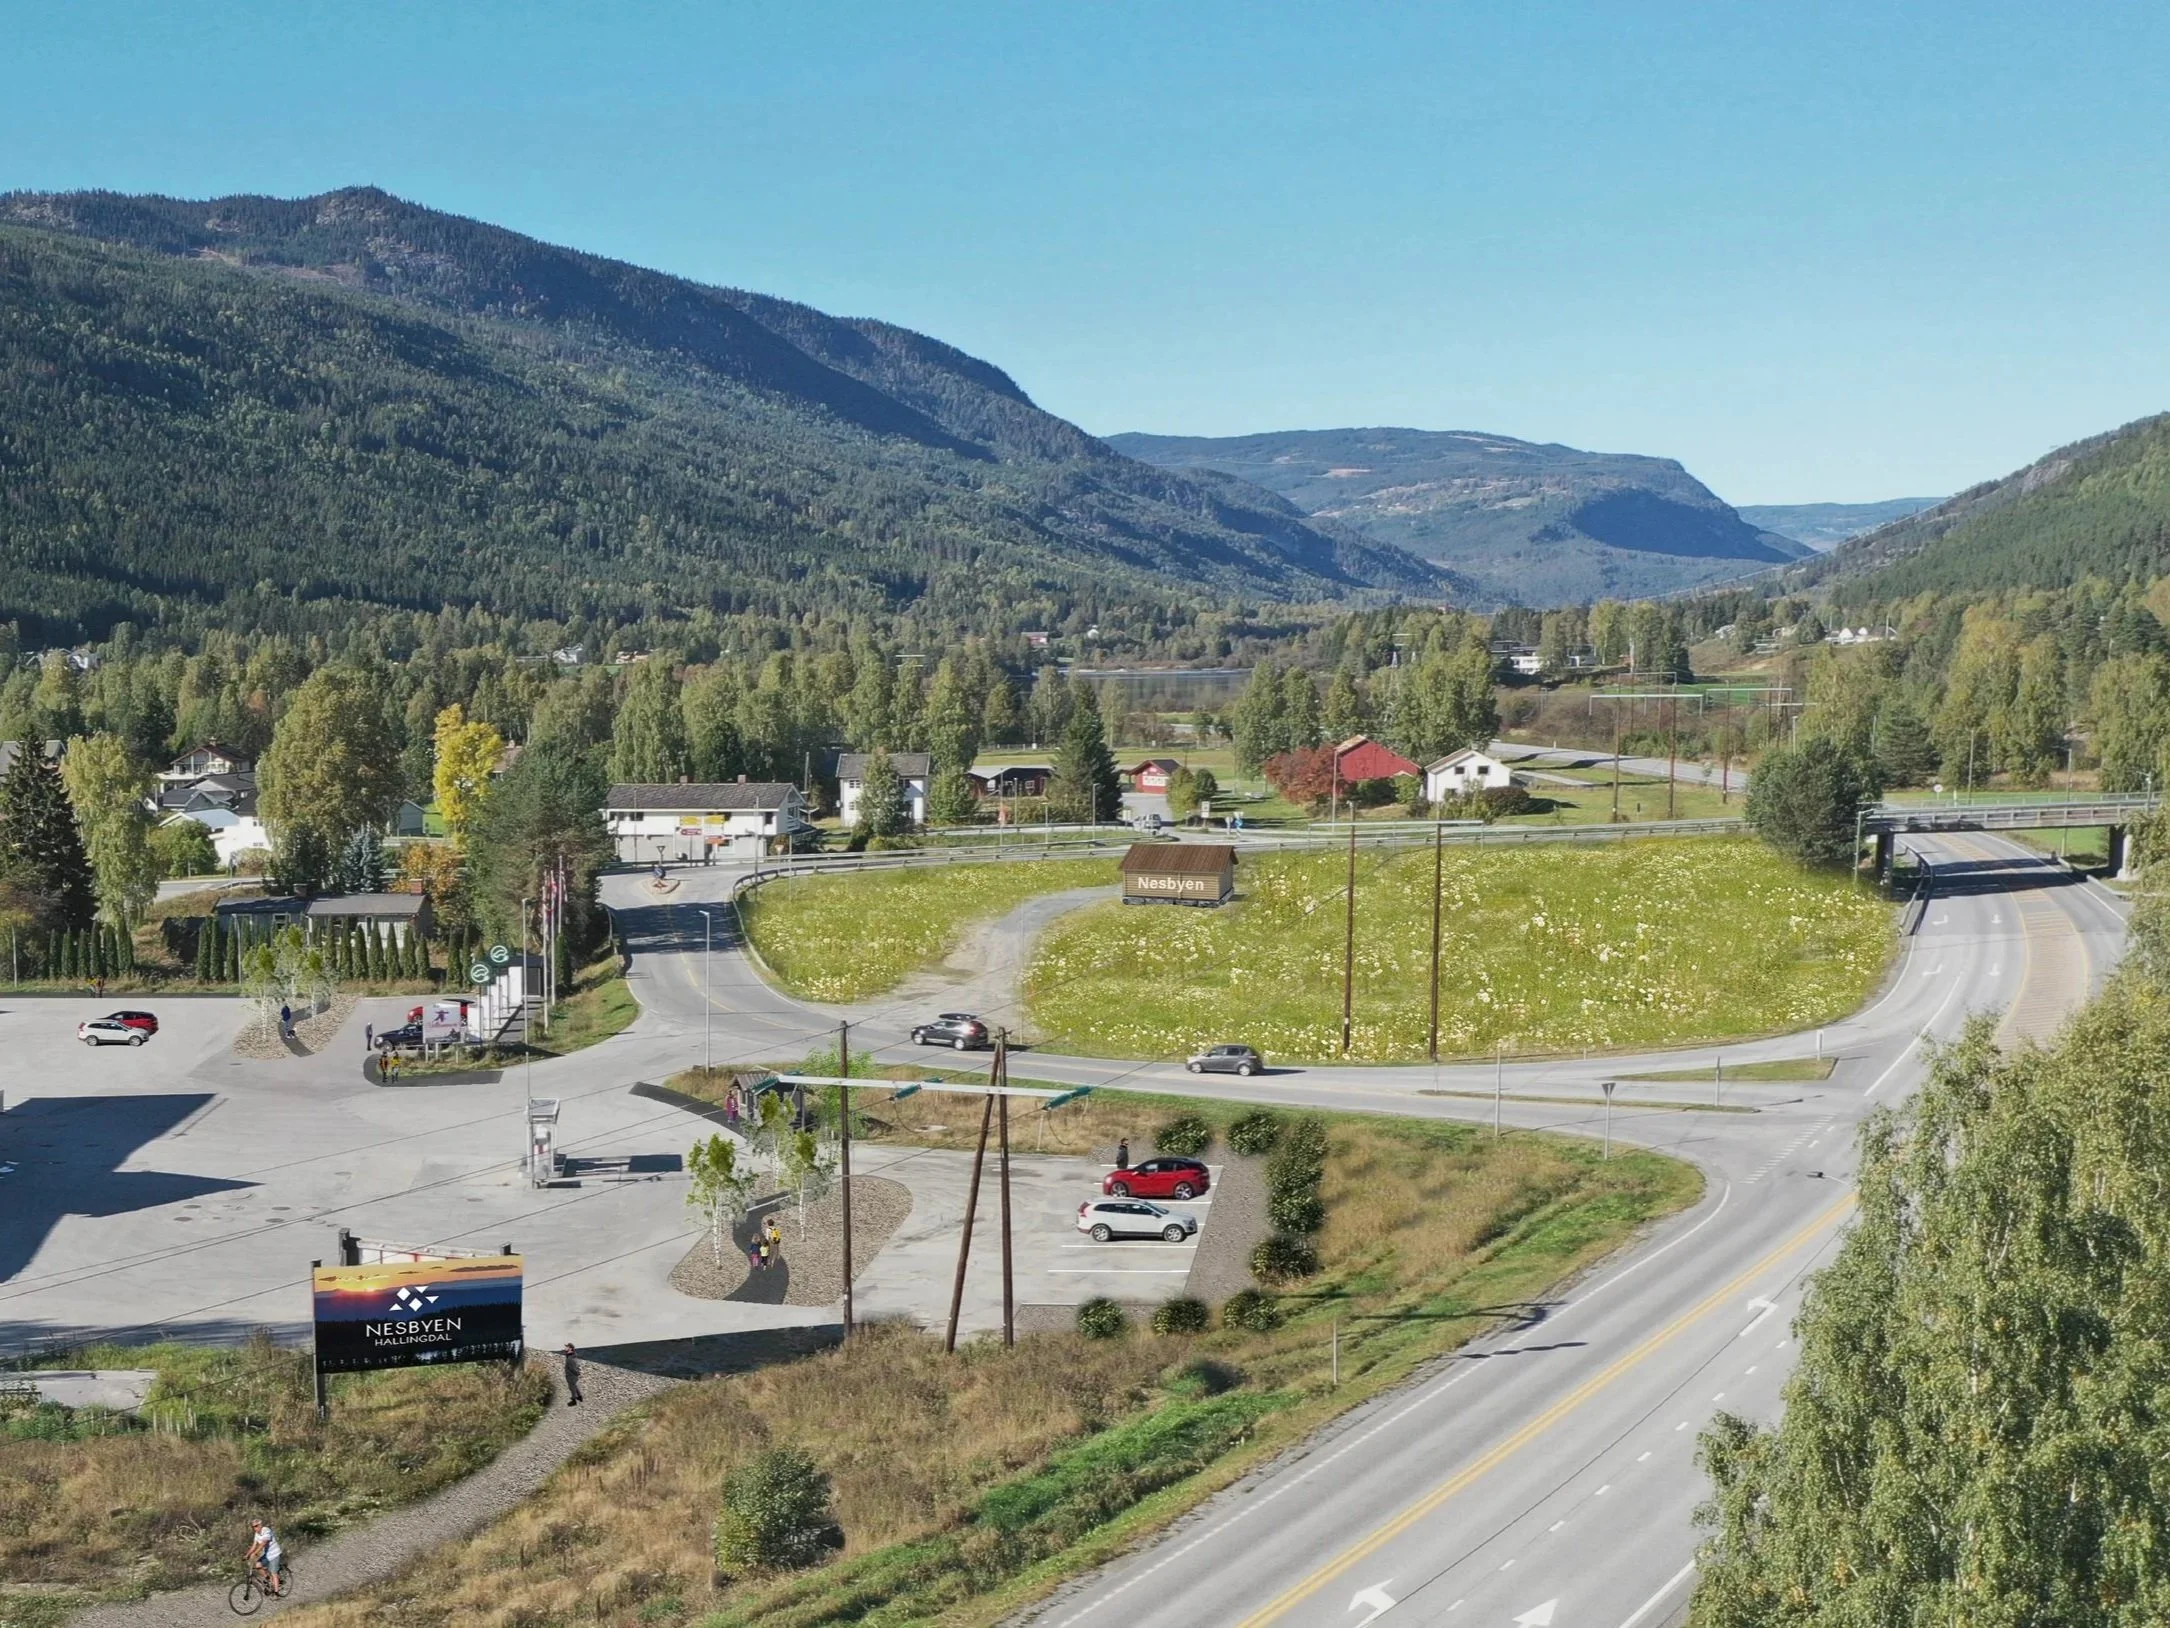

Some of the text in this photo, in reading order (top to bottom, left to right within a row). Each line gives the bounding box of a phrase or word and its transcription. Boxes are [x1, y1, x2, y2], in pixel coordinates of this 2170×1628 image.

[1138, 876, 1204, 892] Nesbyen
[366, 1317, 461, 1337] NESBYEN
[375, 1333, 452, 1346] HALLINGDAL
